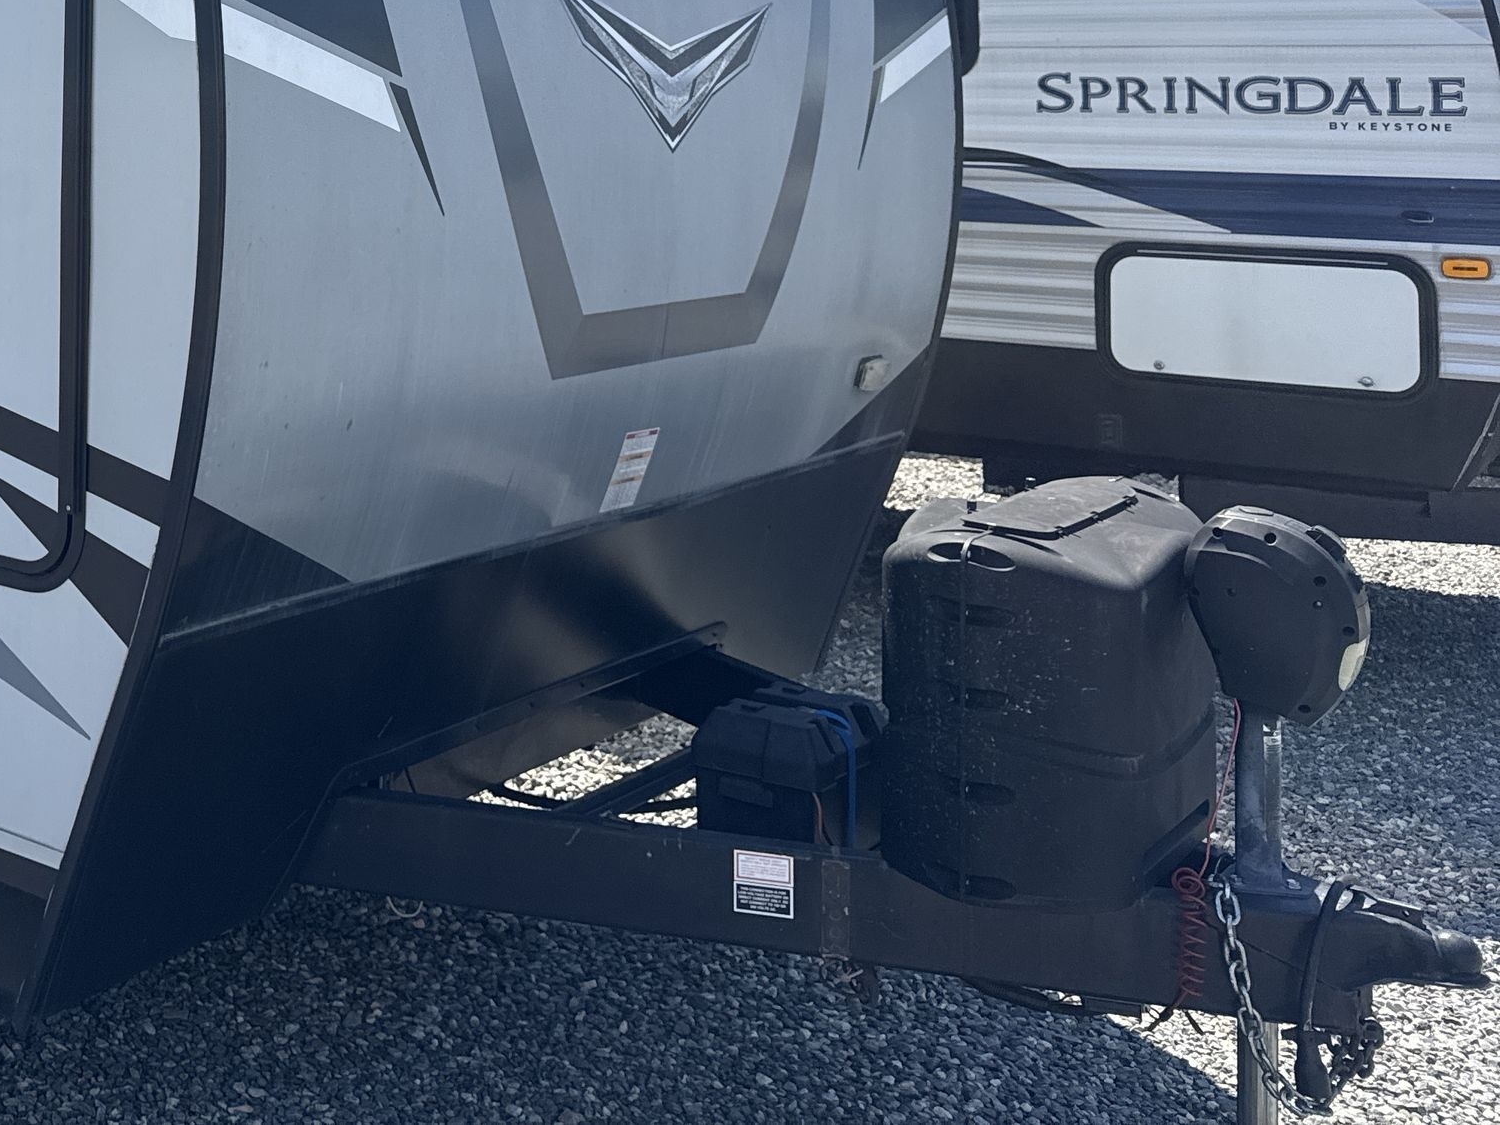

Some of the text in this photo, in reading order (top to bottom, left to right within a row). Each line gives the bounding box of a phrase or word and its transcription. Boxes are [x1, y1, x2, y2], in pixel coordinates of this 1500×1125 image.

[1036, 71, 1468, 117] SPRINGDALE
[1329, 121, 1453, 132] BY KEYSTONE
